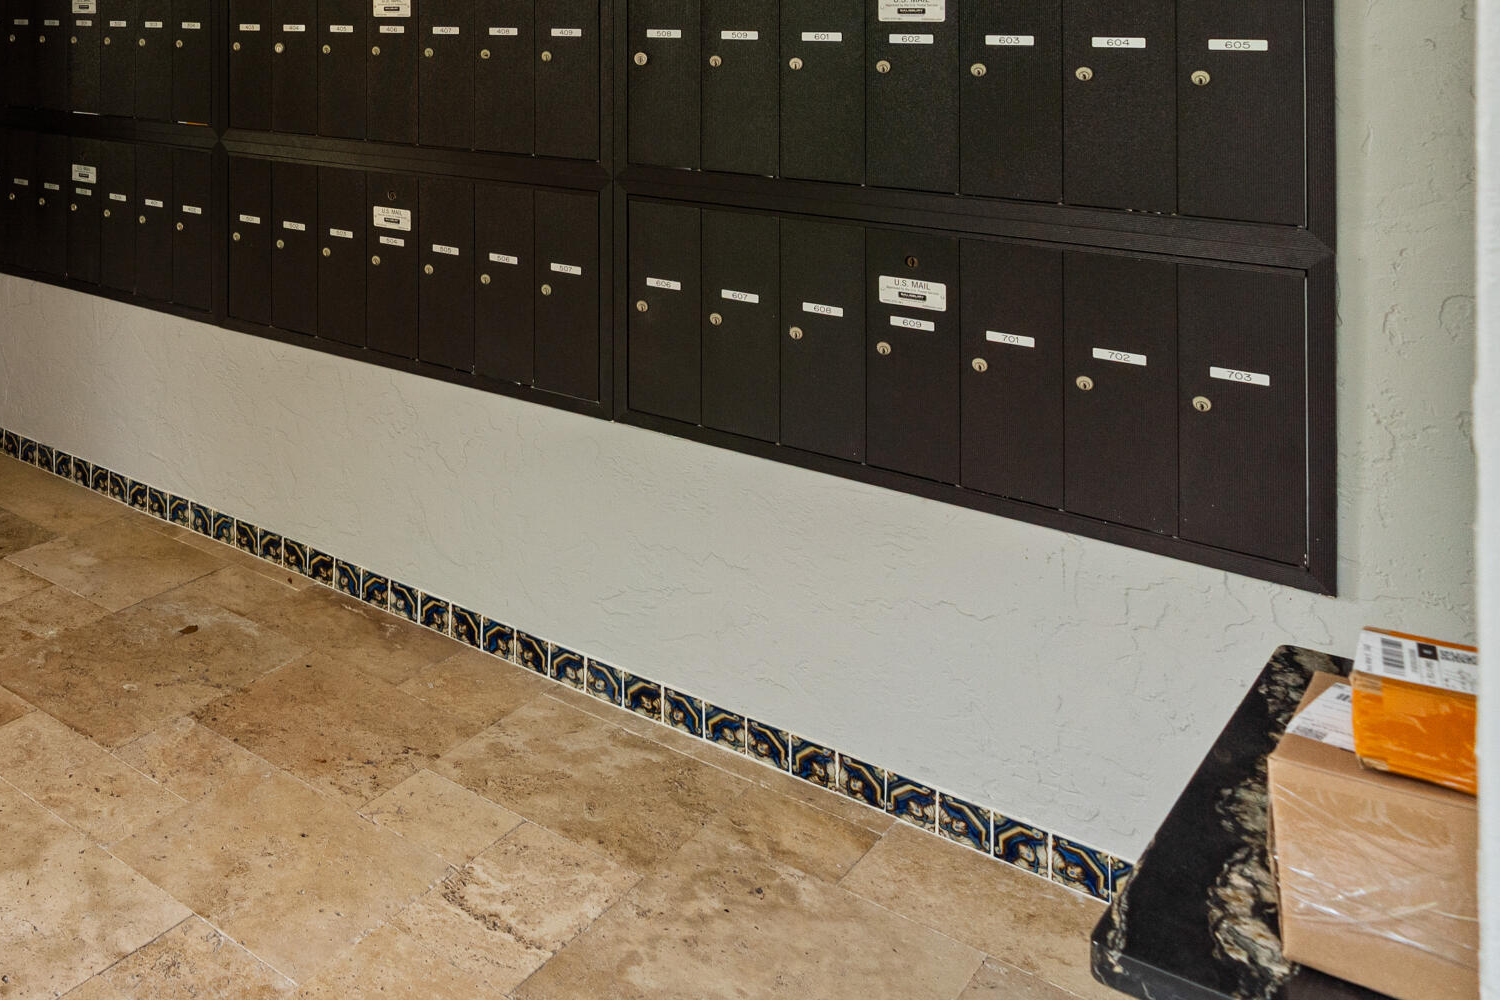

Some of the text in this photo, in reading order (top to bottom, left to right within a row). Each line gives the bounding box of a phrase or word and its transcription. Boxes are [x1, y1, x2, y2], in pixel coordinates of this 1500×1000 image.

[901, 35, 921, 43] 602
[998, 36, 1020, 44] 603
[1106, 38, 1130, 46] 604
[1224, 41, 1251, 49] 605
[655, 280, 672, 288] 606
[894, 279, 931, 290] U.S. MAIL
[731, 292, 748, 300] 607
[813, 305, 832, 314] 608
[902, 319, 922, 328] 609
[1002, 334, 1019, 343] 701
[1108, 351, 1130, 362] 702
[1227, 370, 1252, 381] 703
